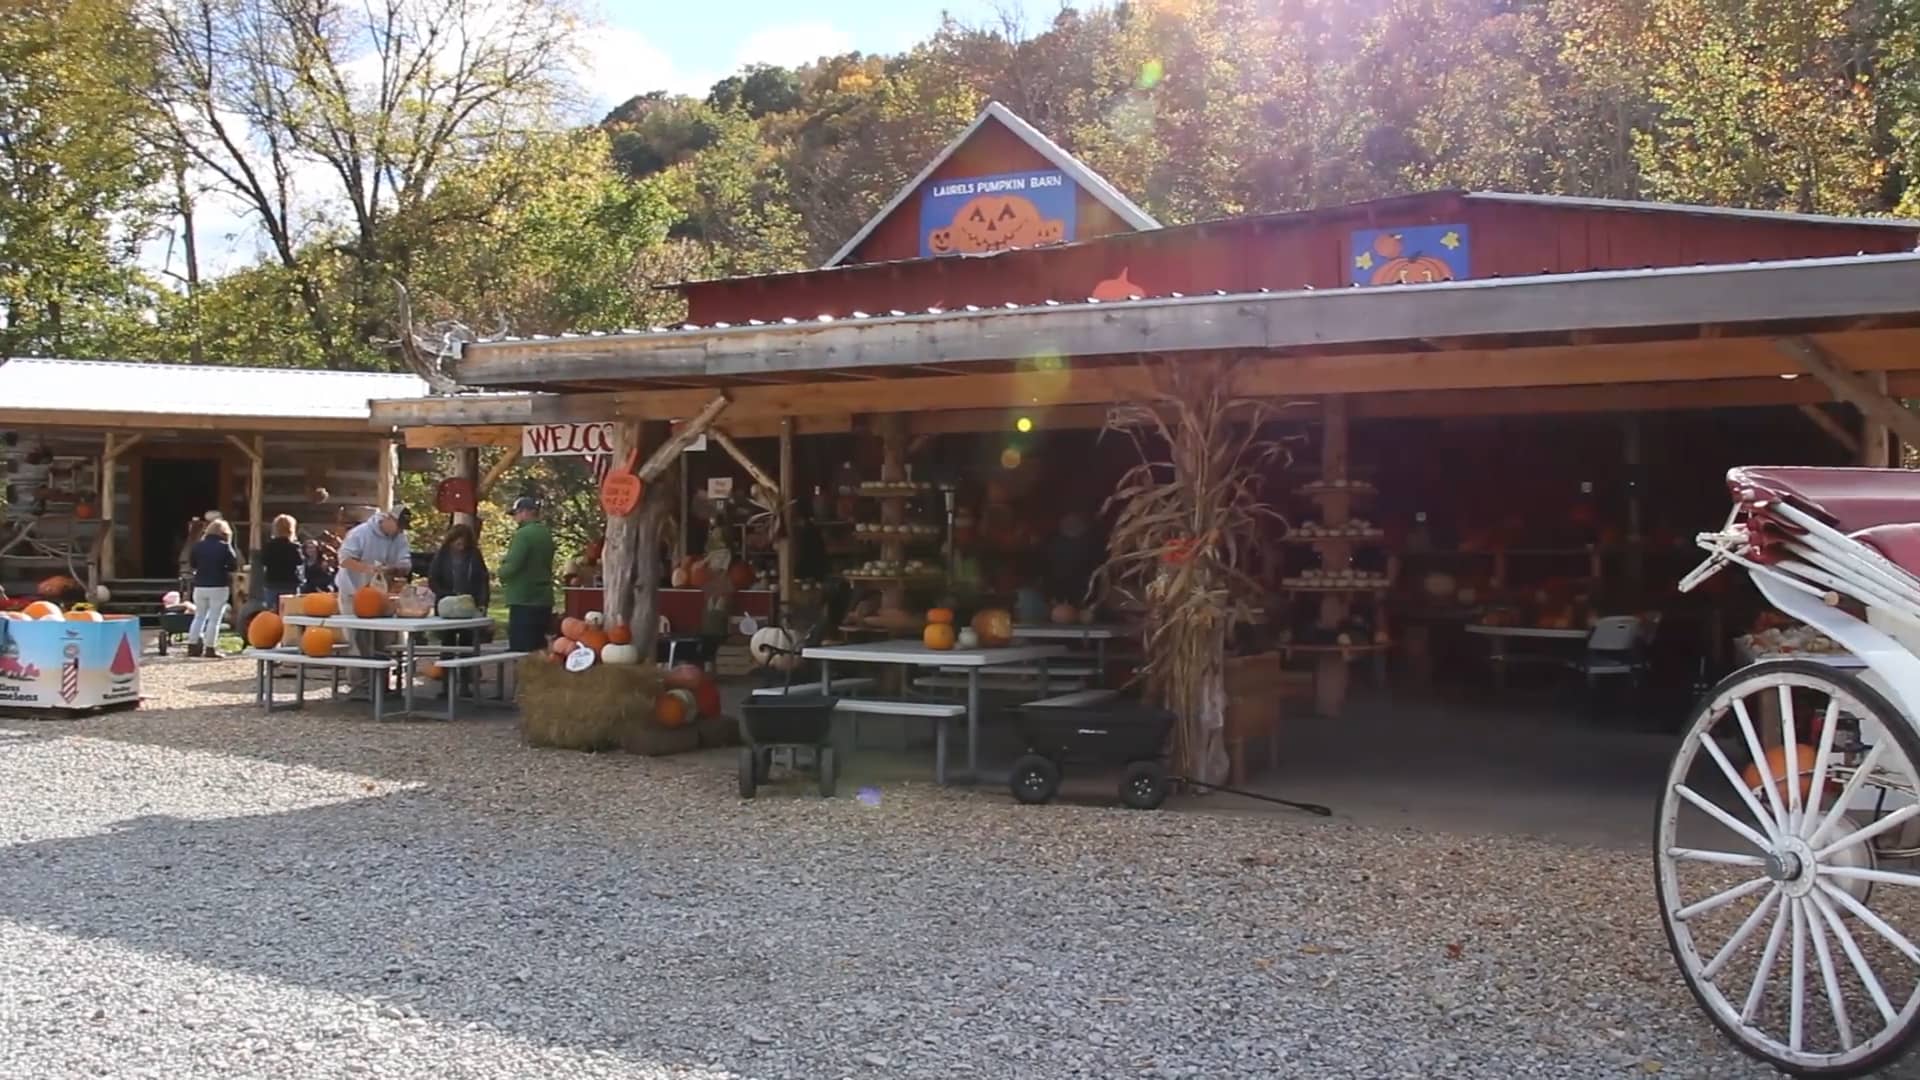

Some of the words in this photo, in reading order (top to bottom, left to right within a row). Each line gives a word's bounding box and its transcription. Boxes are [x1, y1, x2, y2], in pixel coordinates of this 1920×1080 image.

[933, 184, 974, 197] LAURELS
[977, 179, 1025, 193] PUMPKIN
[1030, 176, 1062, 187] BARN
